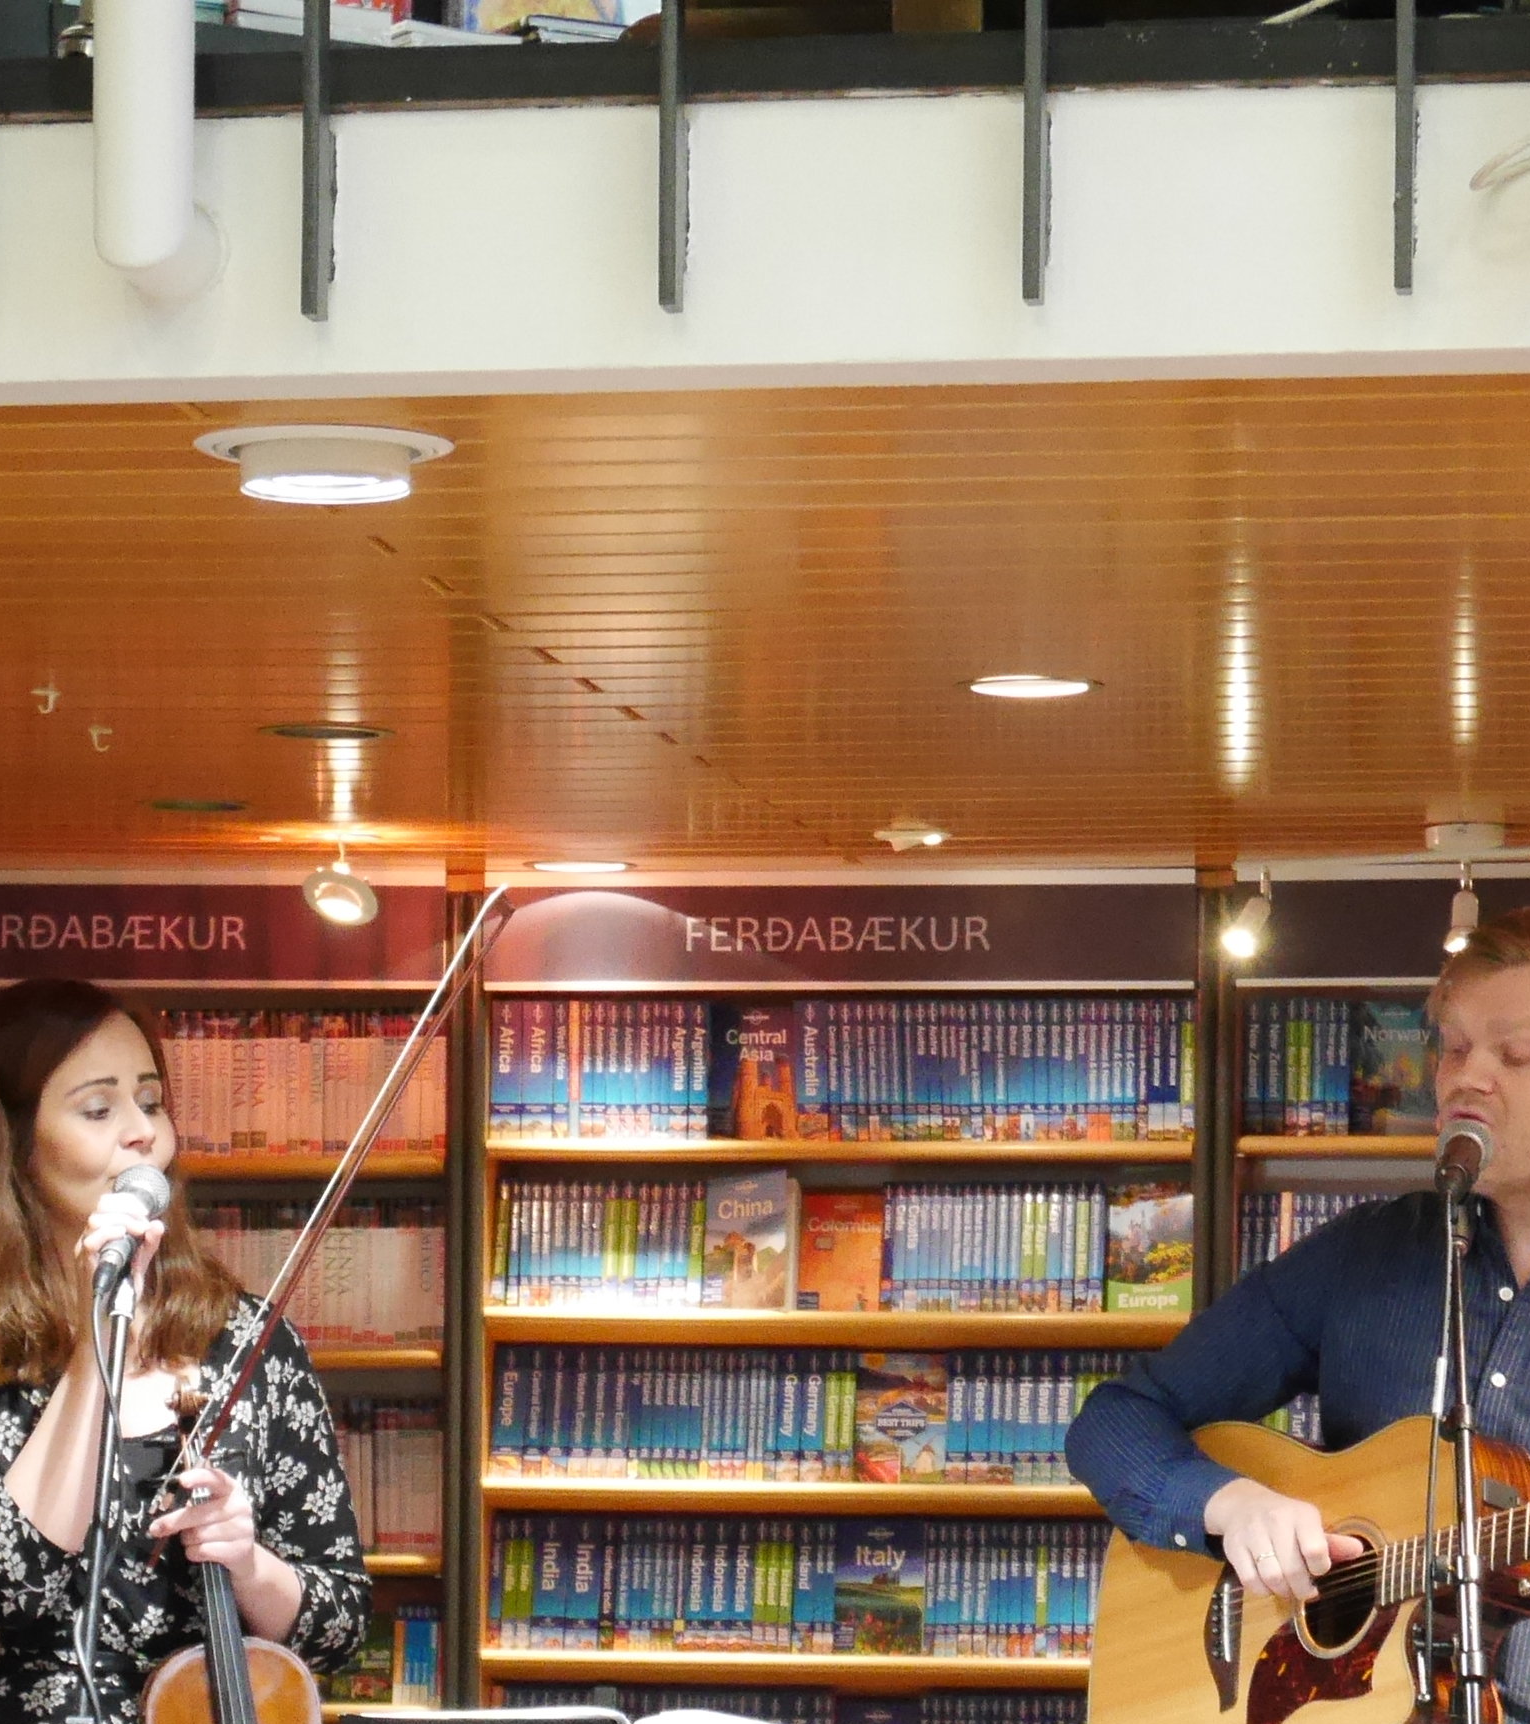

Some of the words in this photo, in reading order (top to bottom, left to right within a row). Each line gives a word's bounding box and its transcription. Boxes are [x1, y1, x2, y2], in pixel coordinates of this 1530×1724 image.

[685, 915, 990, 952] FERÐABÆKUR
[497, 1026, 515, 1073] Africa
[529, 1026, 546, 1073] Africa
[671, 1026, 687, 1091] Argentina
[691, 1026, 707, 1091] Argentina
[726, 1029, 787, 1045] Central
[739, 1046, 774, 1062] Asia
[1363, 1025, 1431, 1045] Norway
[231, 1043, 246, 1109] CHINA
[251, 1043, 265, 1108] CHINA
[803, 1026, 819, 1096] Australia
[718, 1199, 774, 1219] China
[907, 1204, 919, 1248] Croatia
[1118, 1293, 1179, 1310] Europe
[500, 1372, 518, 1426] Europe
[779, 1374, 797, 1436] Germany
[803, 1374, 823, 1436] Germany
[877, 1418, 898, 1427] BEST
[901, 1418, 925, 1427] TRIPS
[953, 1376, 965, 1422] Greece
[975, 1376, 987, 1422] Greece
[1017, 1376, 1033, 1424] Hawaii
[1037, 1376, 1053, 1424] Hawaii
[1057, 1376, 1073, 1424] Hawaii
[541, 1542, 561, 1591] India
[575, 1543, 595, 1594] India
[690, 1545, 705, 1612] Indonesia
[713, 1545, 727, 1612] Indonesia
[735, 1545, 750, 1612] Indonesia
[799, 1545, 811, 1590] Ireland
[856, 1545, 906, 1571] Italy
